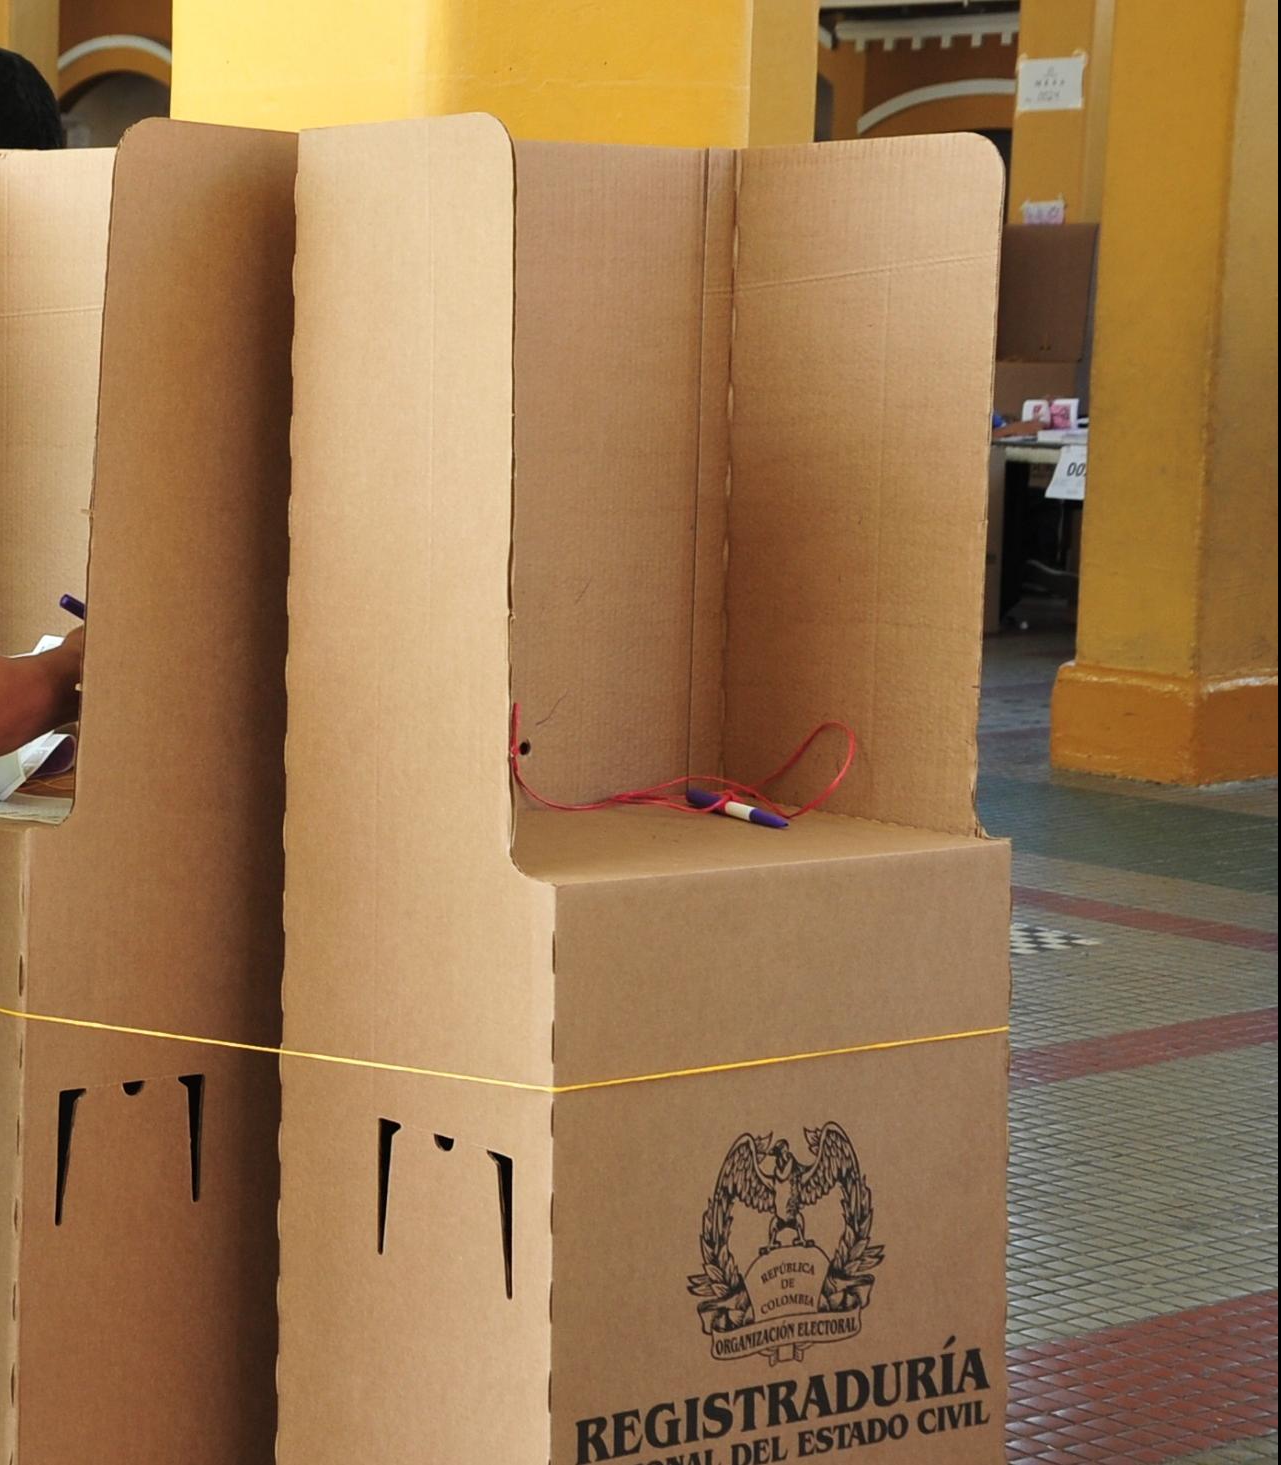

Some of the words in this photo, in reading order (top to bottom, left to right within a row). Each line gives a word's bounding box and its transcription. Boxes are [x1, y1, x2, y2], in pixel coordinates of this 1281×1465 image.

[1067, 462, 1086, 477] 00
[760, 1261, 815, 1284] REPÚBLICA
[780, 1278, 795, 1290] DE
[760, 1294, 815, 1315] COLOMBIA
[715, 1320, 795, 1355] ORGANIZACIÓN
[797, 1317, 857, 1340] ELECTORAL
[575, 1335, 991, 1465] REGISTRADURÍA
[730, 1436, 788, 1465] DEL
[798, 1413, 909, 1458] ESTADO
[917, 1400, 991, 1435] CIVIL
